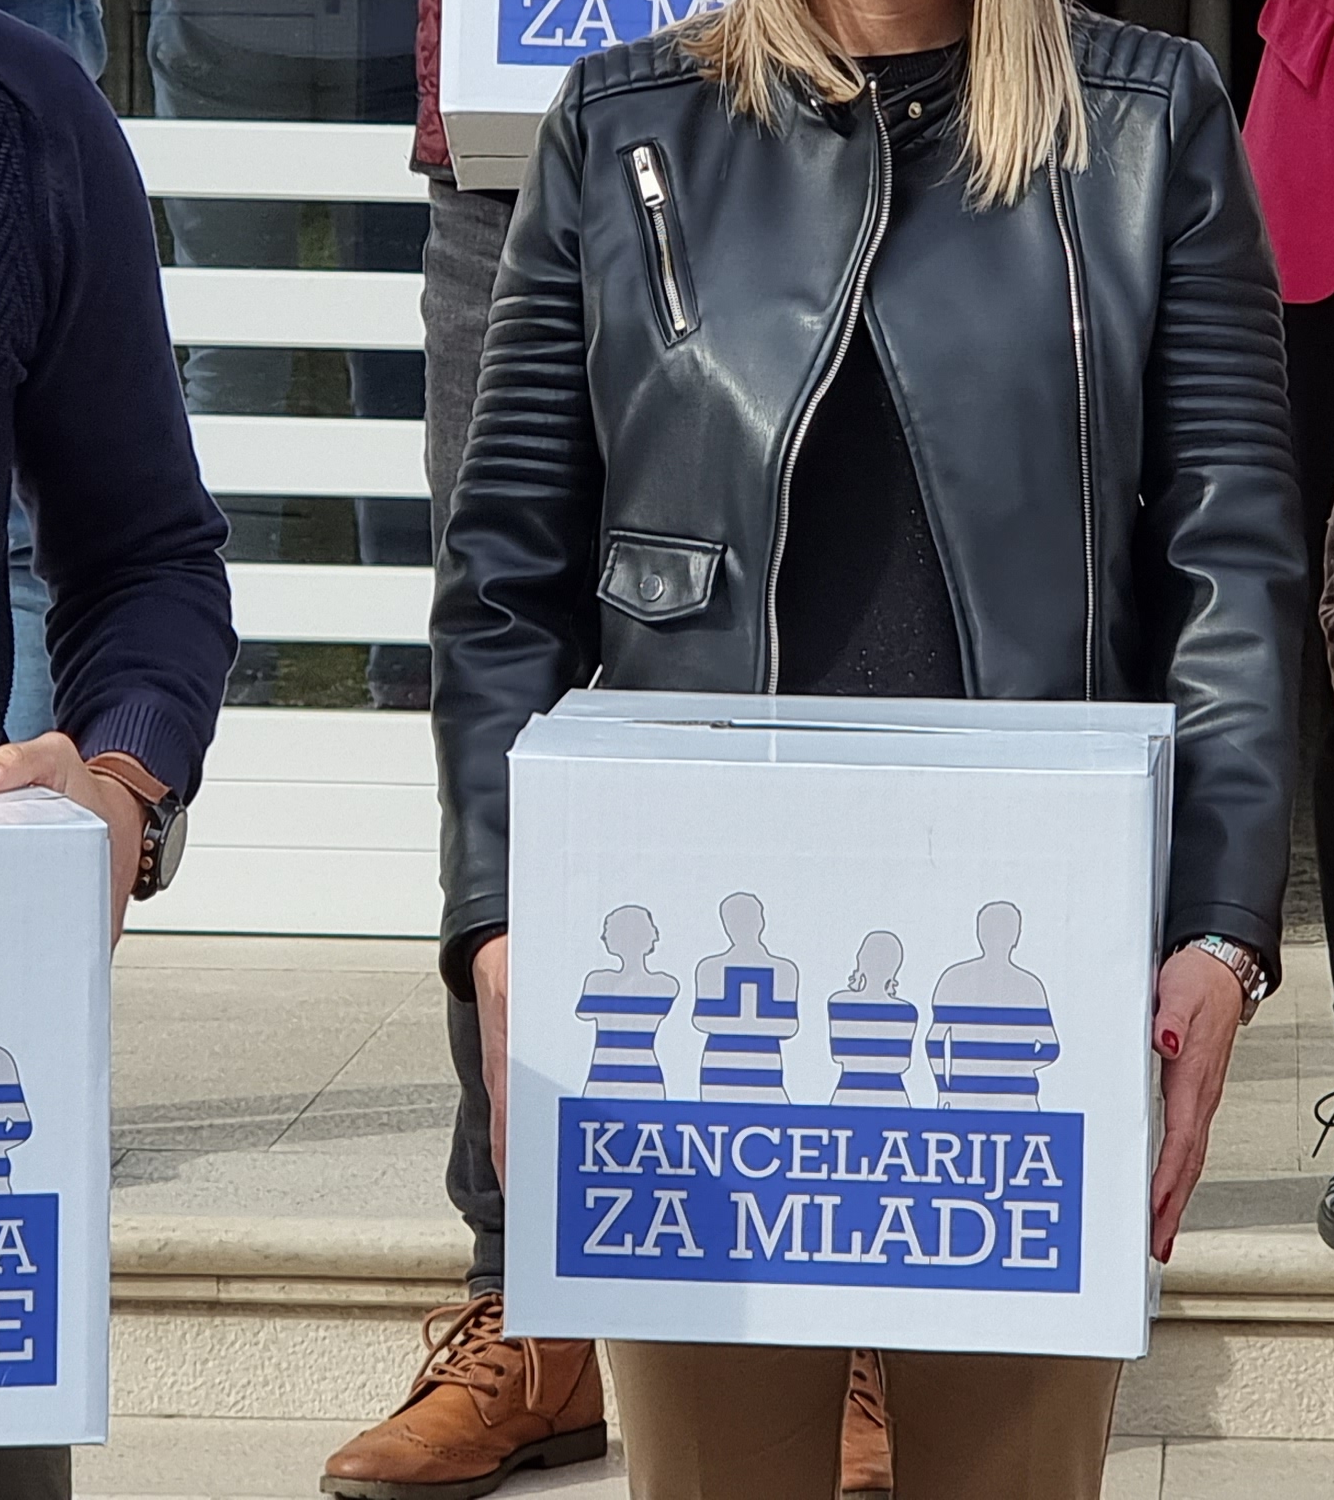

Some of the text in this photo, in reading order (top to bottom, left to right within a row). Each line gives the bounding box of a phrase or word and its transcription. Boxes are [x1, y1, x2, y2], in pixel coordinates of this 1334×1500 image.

[578, 1121, 1064, 1201] KANCELARIJA
[582, 1187, 1061, 1270] ZA MLADE
